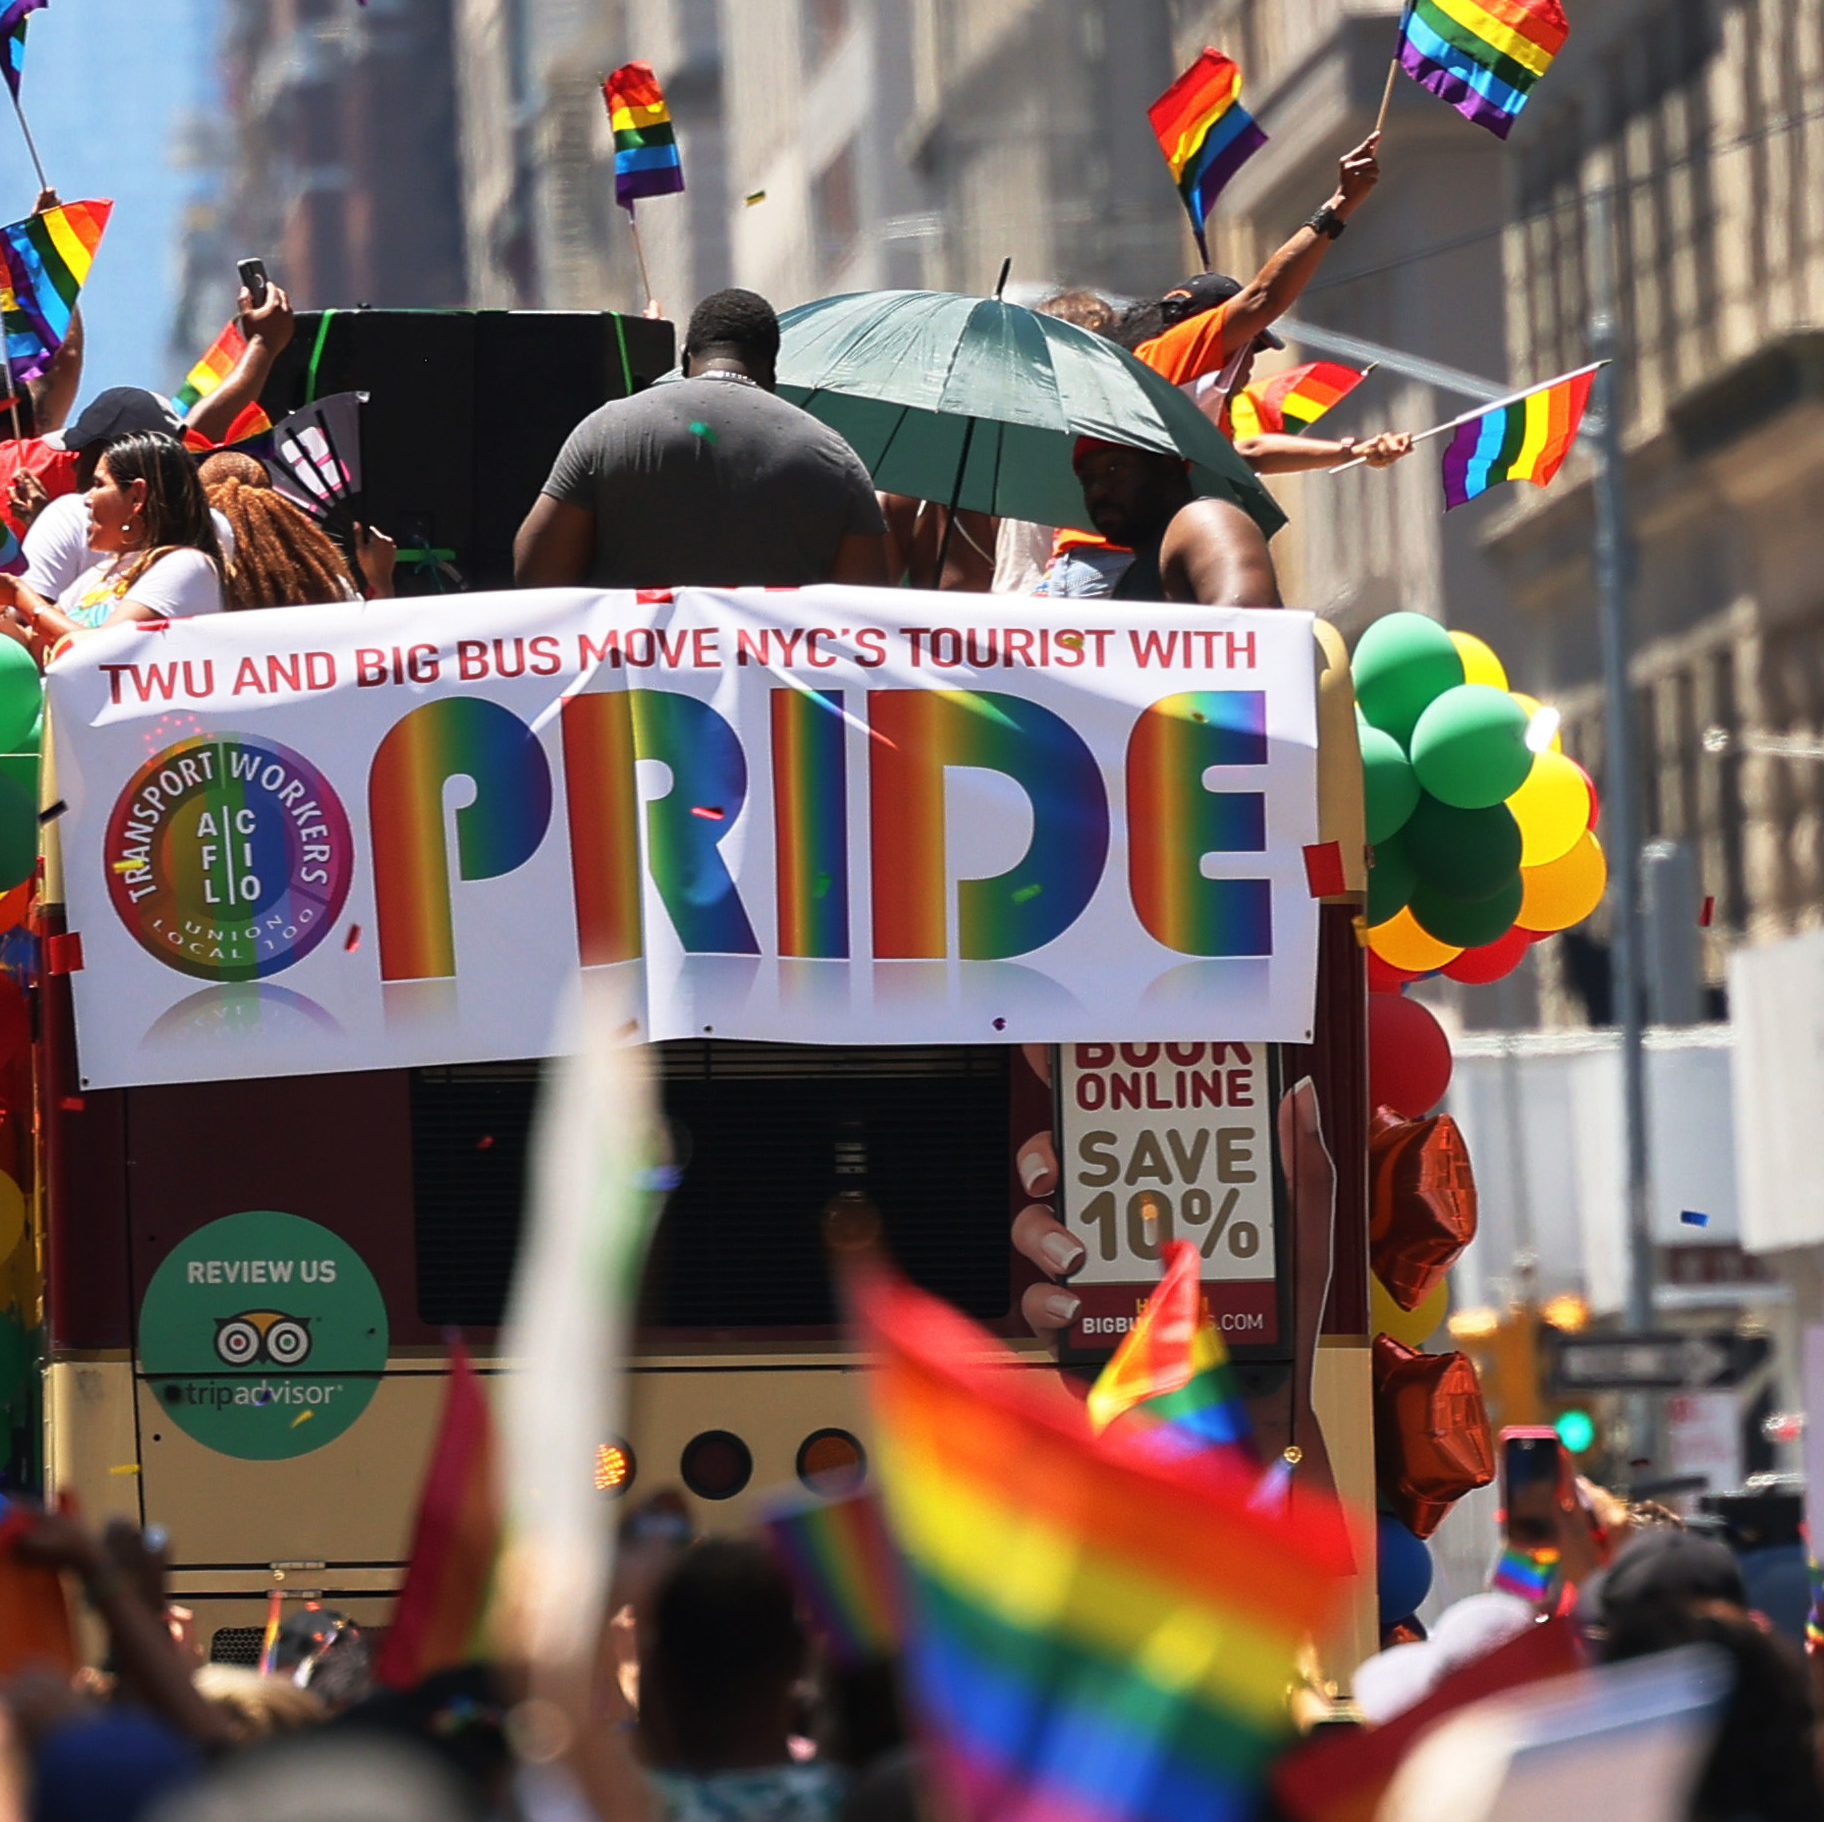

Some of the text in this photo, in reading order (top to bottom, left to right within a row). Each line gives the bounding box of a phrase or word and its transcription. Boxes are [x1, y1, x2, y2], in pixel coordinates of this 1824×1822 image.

[98, 626, 1258, 706] TWU AND BIG BUS MOVE NYC'S TOURIST WITH
[123, 749, 331, 905] TRANSPORT WORKERS
[367, 686, 1274, 983] PRIDE
[152, 908, 314, 959] LOCAL 100
[185, 914, 283, 942] UNION
[1074, 1041, 1253, 1070] BOOK
[1075, 1068, 1255, 1112] ONLINE
[1077, 1126, 1258, 1189] SAVE
[1079, 1186, 1261, 1263] 10%
[187, 1259, 338, 1284] REVIEW US
[186, 1378, 335, 1411] tripadvisor
